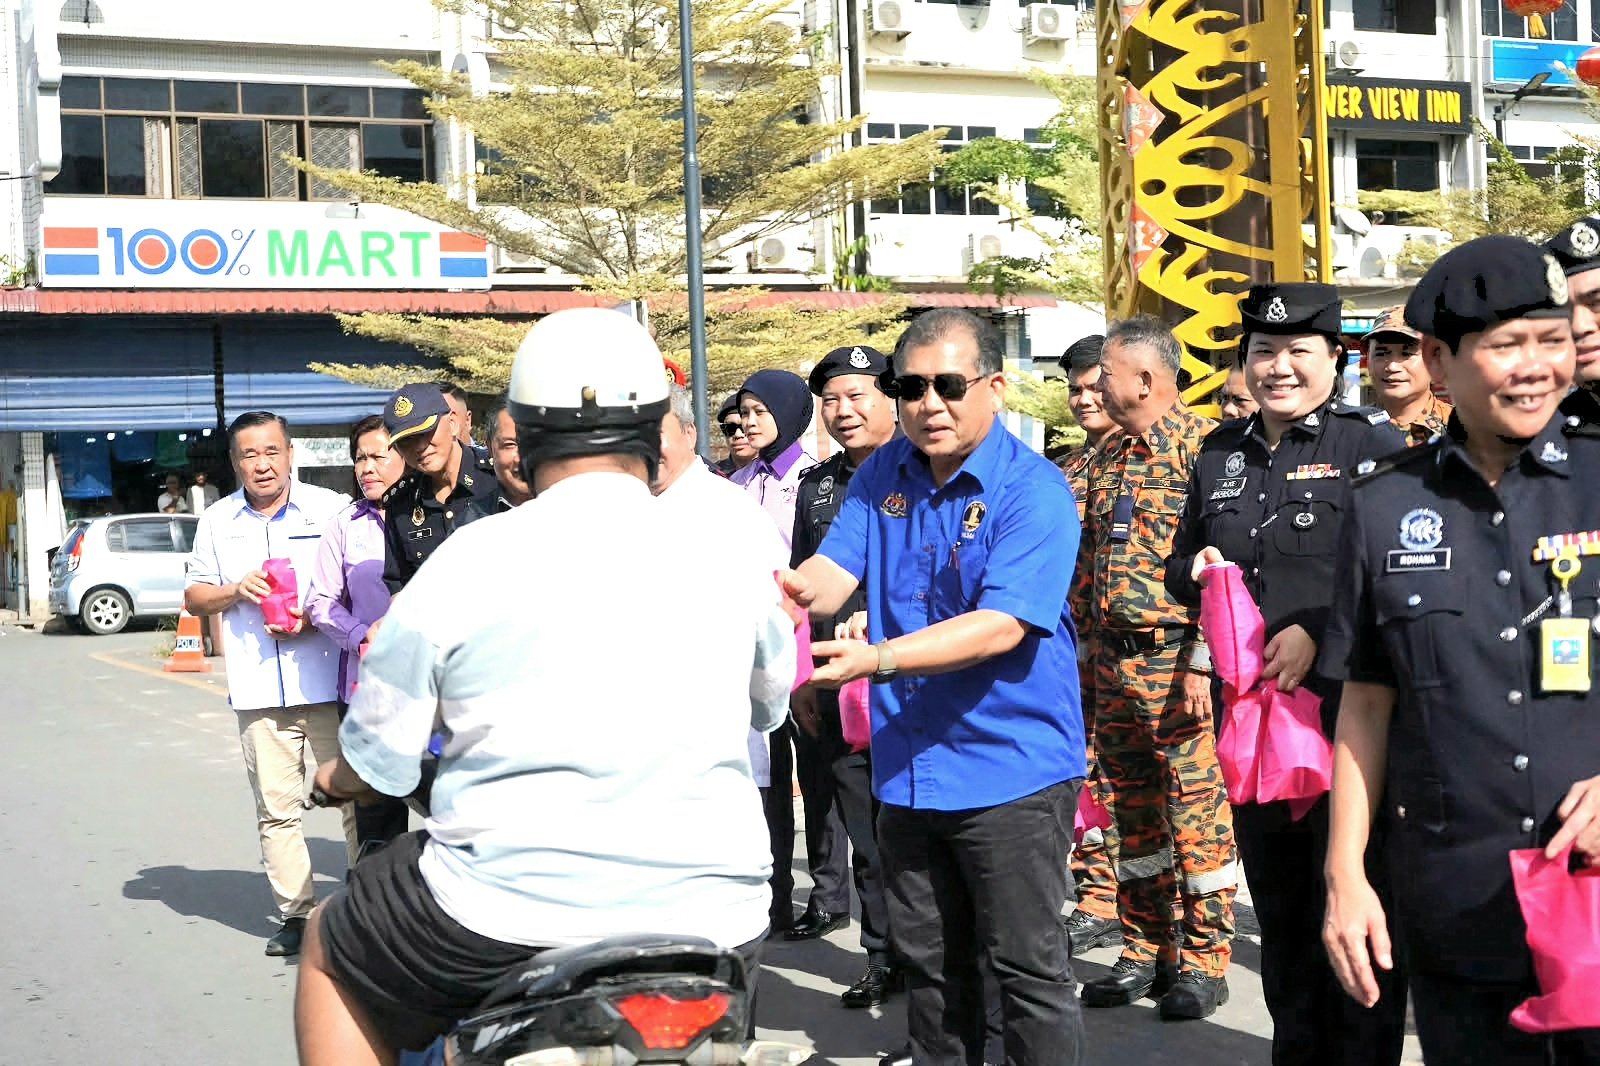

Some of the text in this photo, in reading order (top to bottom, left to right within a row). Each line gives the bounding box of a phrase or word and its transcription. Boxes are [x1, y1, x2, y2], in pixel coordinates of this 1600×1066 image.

[1368, 86, 1420, 122] VIEW
[1426, 89, 1462, 124] INN
[107, 227, 432, 278] 100% MART
